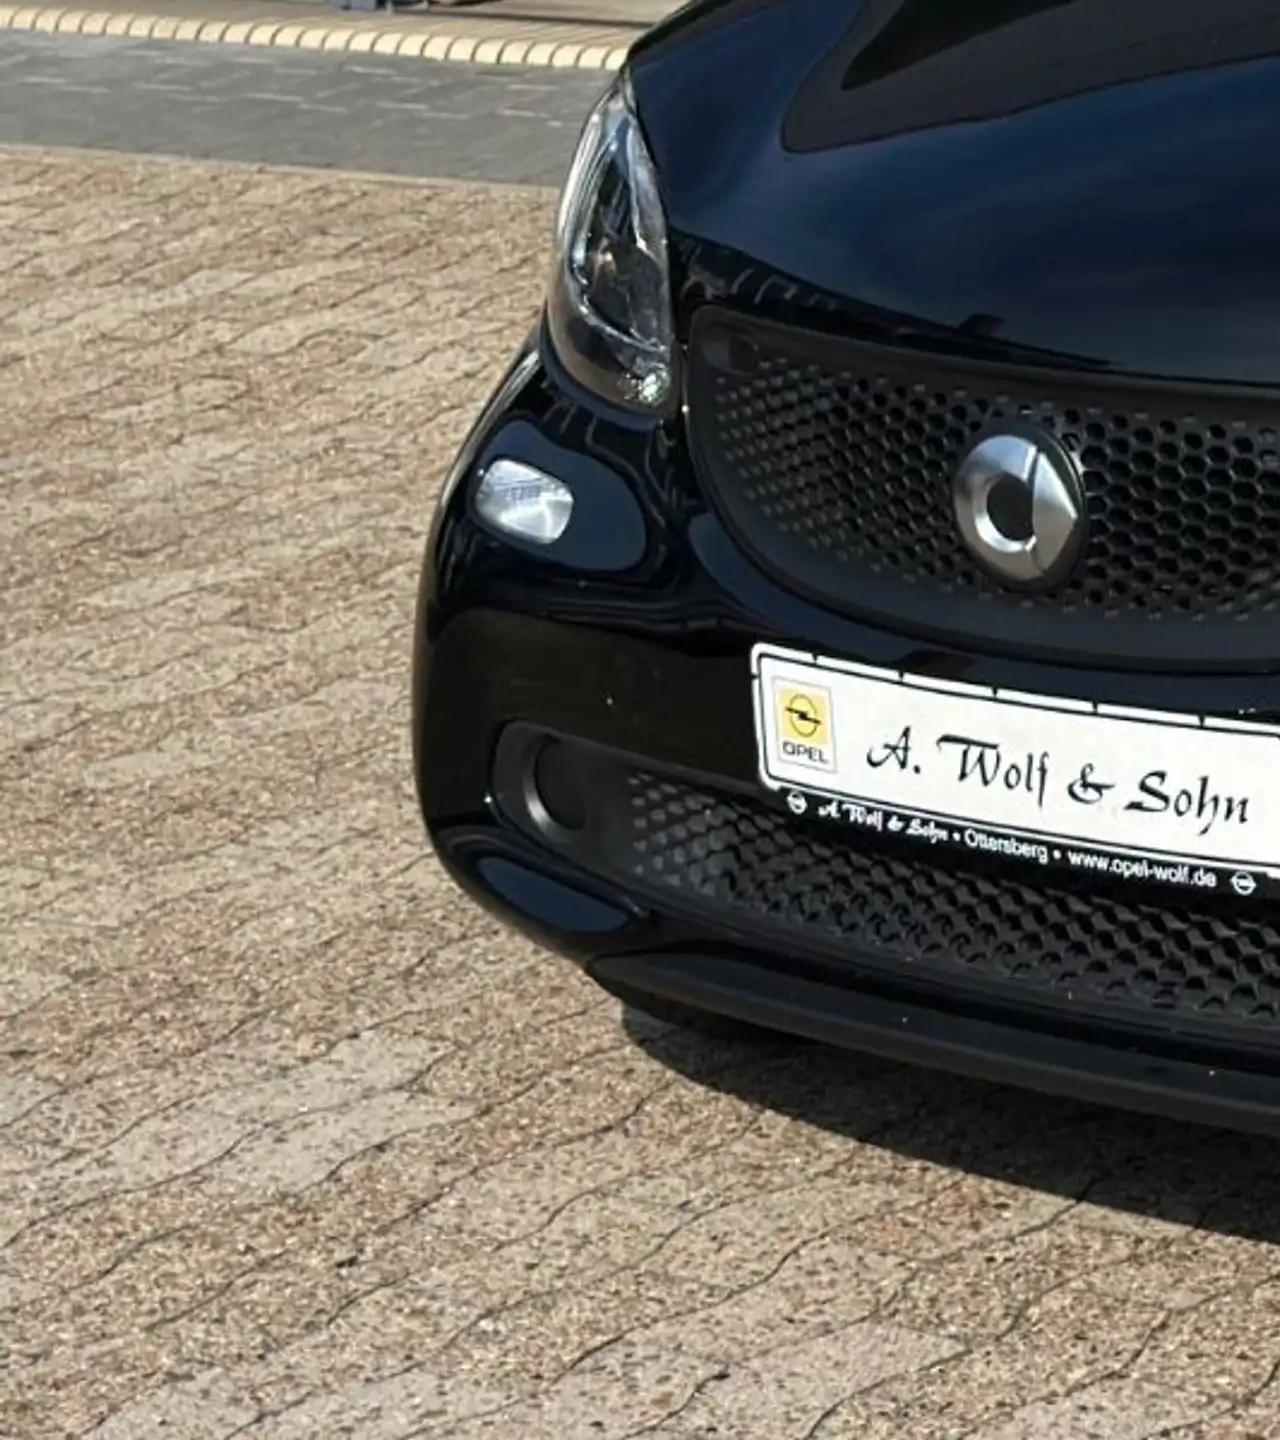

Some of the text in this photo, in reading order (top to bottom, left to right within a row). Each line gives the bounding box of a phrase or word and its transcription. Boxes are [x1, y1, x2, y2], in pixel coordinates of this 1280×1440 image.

[782, 741, 828, 765] OPEL
[866, 725, 1249, 836] A. Wolf & Sohn
[964, 828, 1048, 865] Ottersberg
[1067, 849, 1218, 888] www.opel-wolf.de
